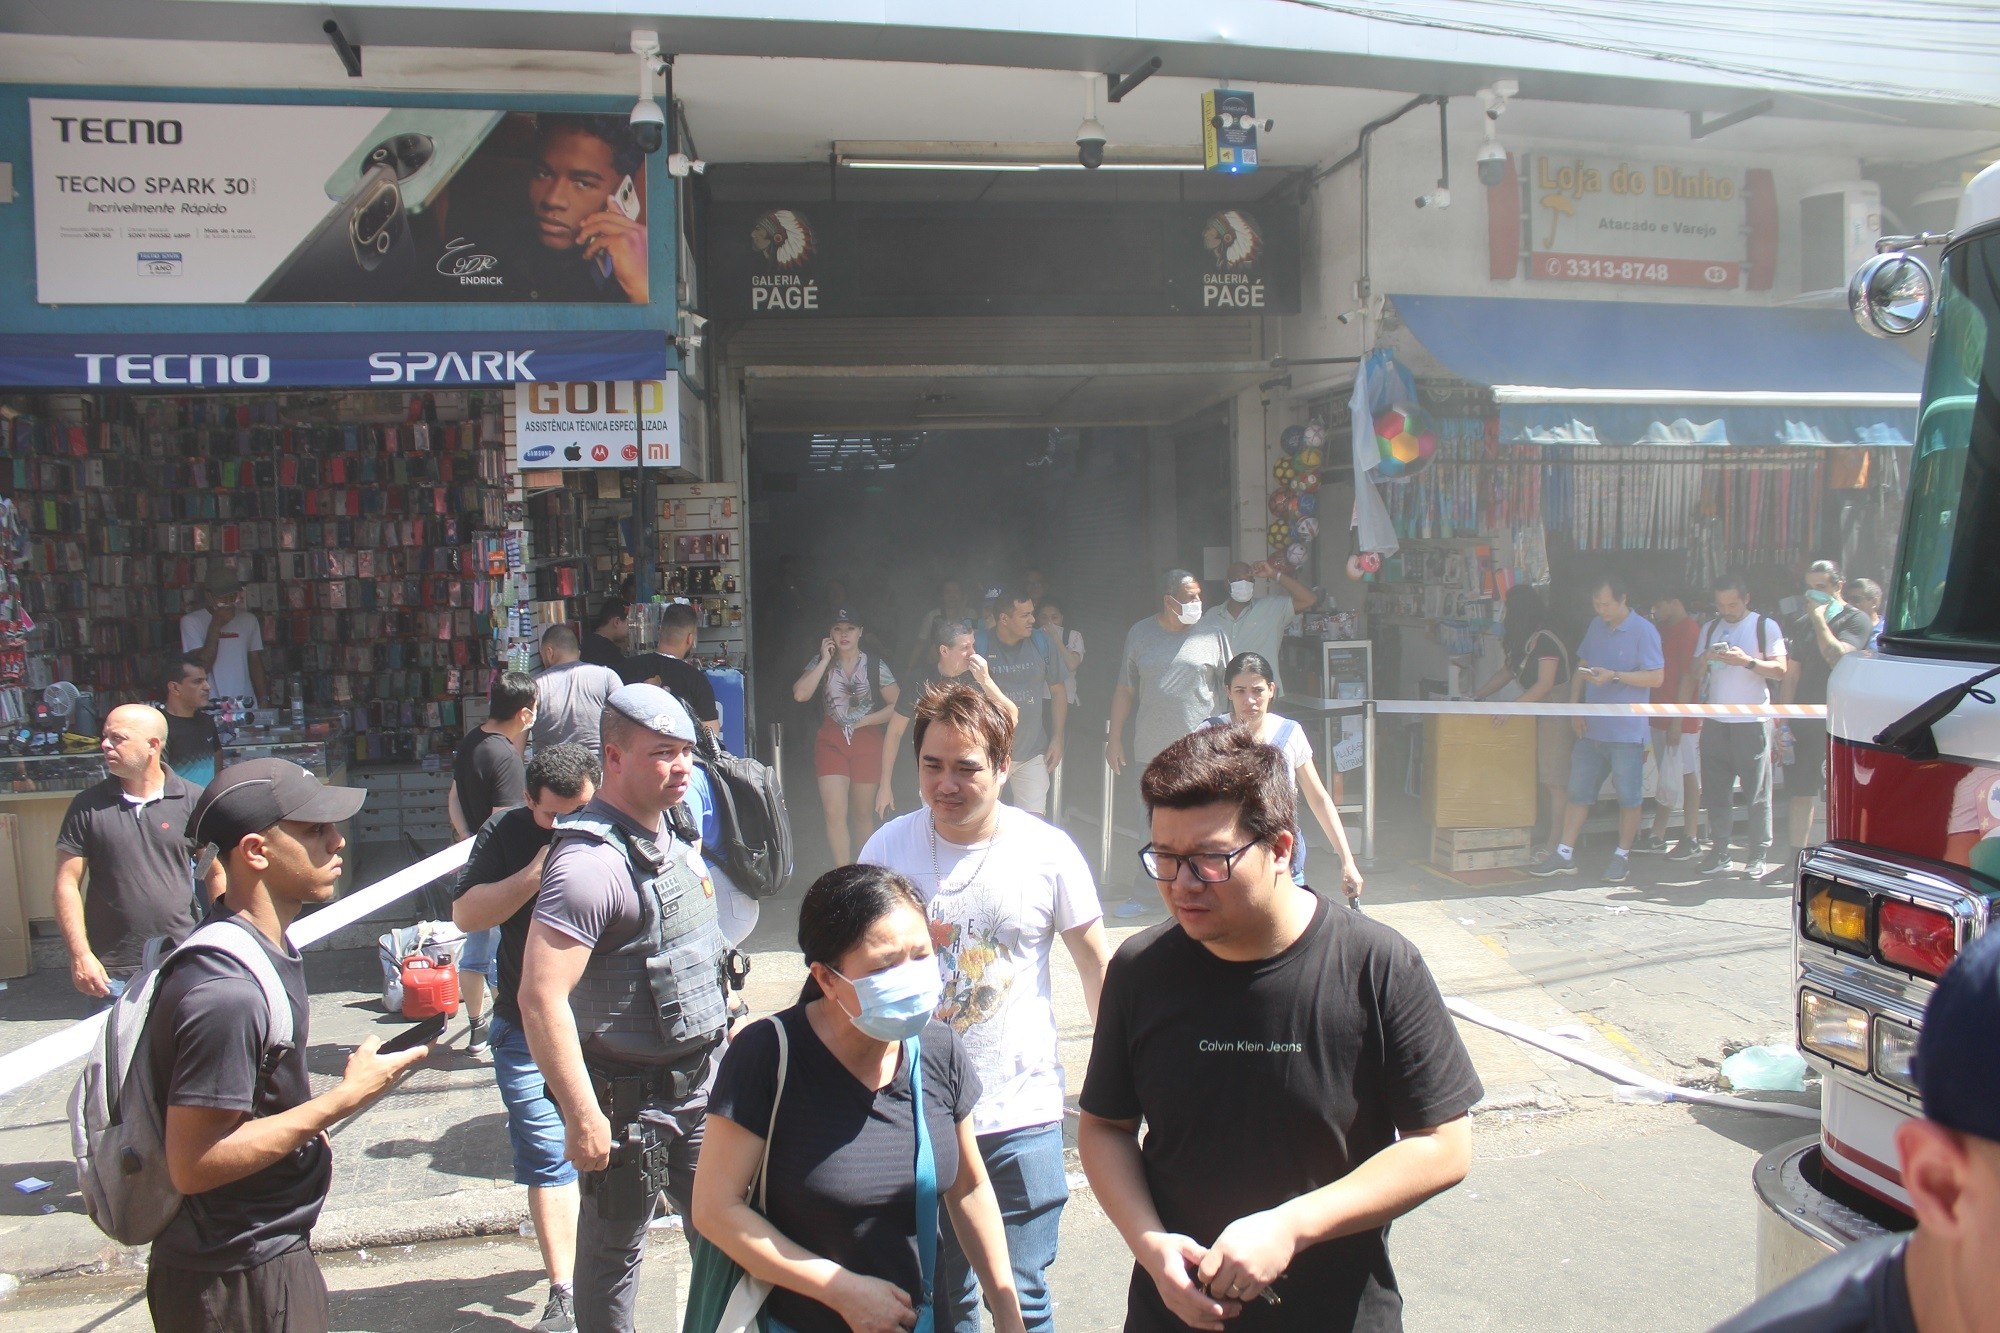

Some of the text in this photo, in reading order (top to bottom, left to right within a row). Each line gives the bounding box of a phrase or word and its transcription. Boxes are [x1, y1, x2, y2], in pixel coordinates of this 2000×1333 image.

[51, 117, 183, 145] TECNO
[56, 175, 136, 193] TECNO
[144, 177, 217, 195] SPARK
[224, 178, 250, 195] 30
[1538, 157, 1736, 201] Loja do Dinho
[87, 201, 228, 215] Incrivelmente Rápido
[1598, 217, 1718, 238] Atacado e Varejo
[1203, 274, 1249, 284] GALERIA
[1567, 259, 1670, 281] 3313-8748
[460, 276, 503, 285] ENDRICK
[752, 275, 800, 286] GALERIA
[752, 279, 819, 310] PAGÉ
[1204, 279, 1265, 307] PAGÉ
[74, 350, 536, 384] TECNO SPARK
[528, 380, 664, 415] GOLD
[525, 418, 575, 432] ASSISTÊNCIA
[609, 419, 668, 432] ESPECILIZADA
[526, 448, 552, 458] SAMSUNG
[1199, 1039, 1302, 1053] Calvin Klein Jeans
